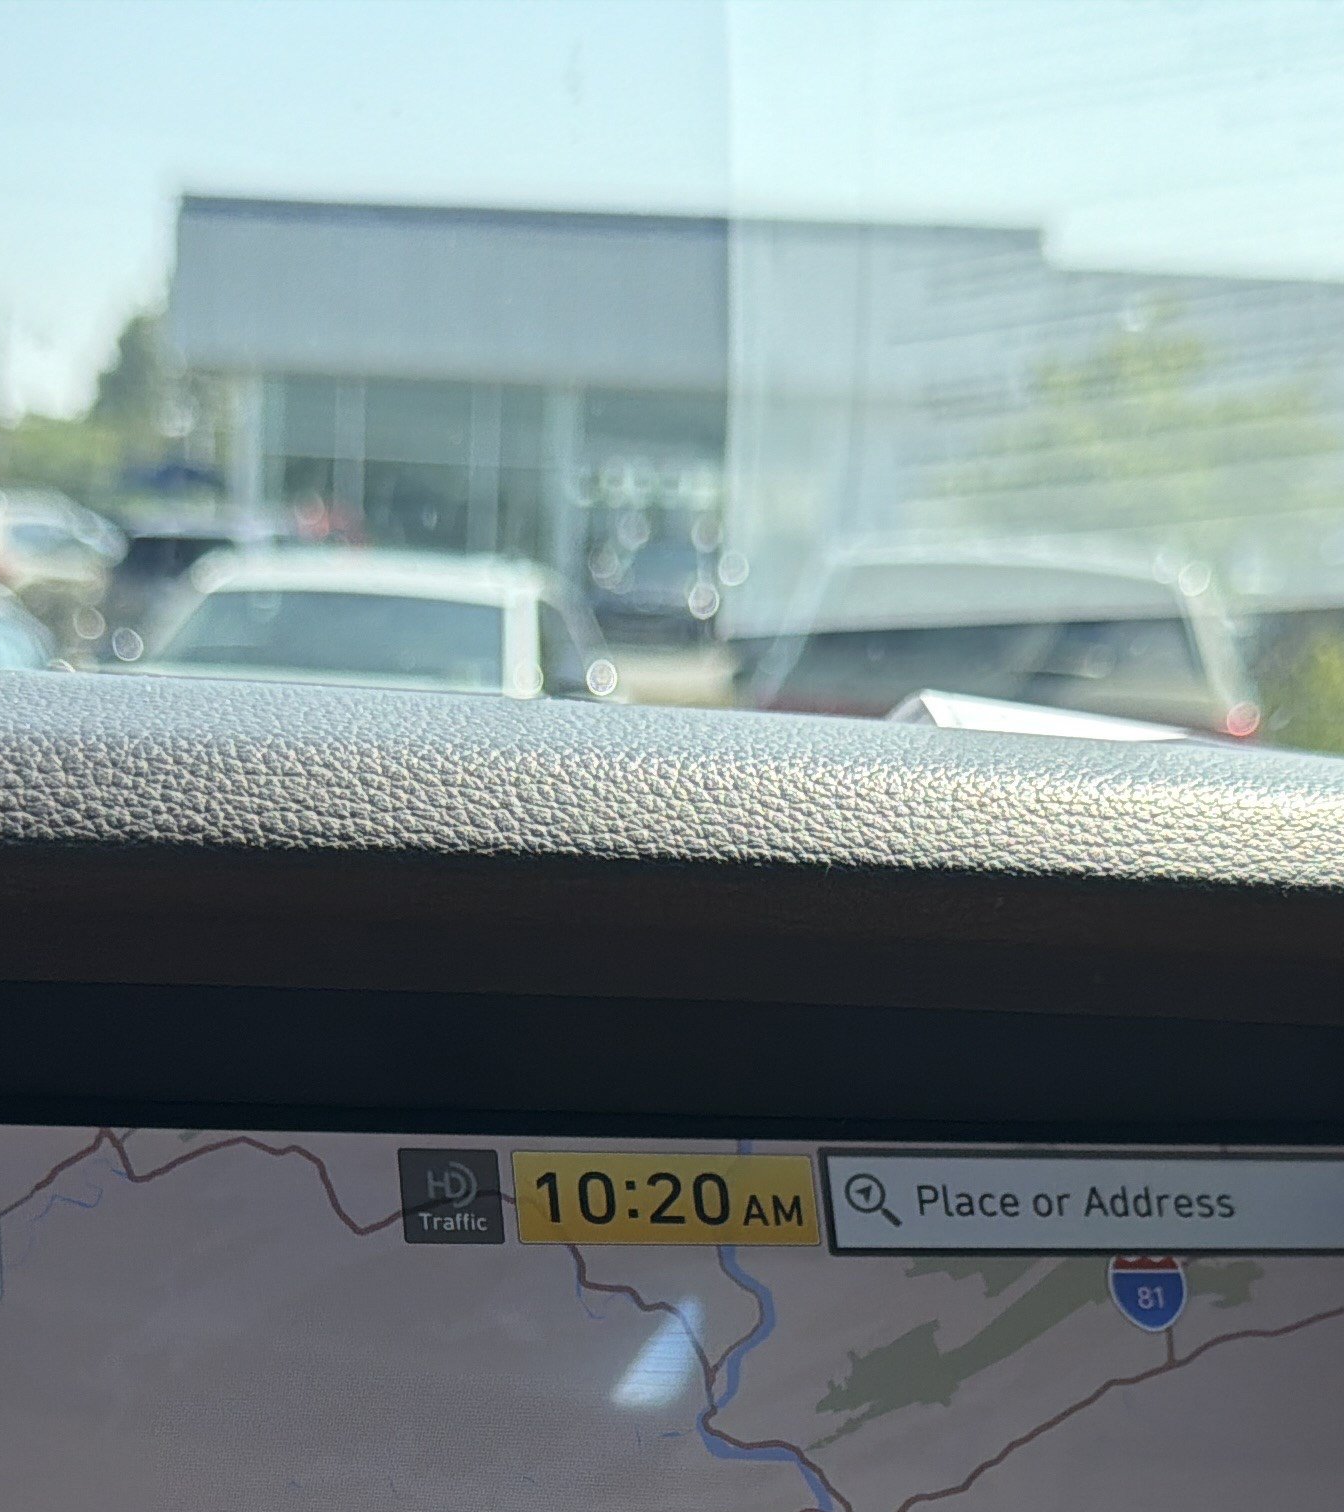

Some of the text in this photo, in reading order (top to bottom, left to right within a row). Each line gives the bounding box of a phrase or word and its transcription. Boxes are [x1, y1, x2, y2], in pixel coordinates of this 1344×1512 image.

[535, 1170, 805, 1227] 10:20 AM
[915, 1183, 1237, 1220] Place or Address
[418, 1212, 488, 1231] Traffic
[1136, 1287, 1165, 1310] 81
